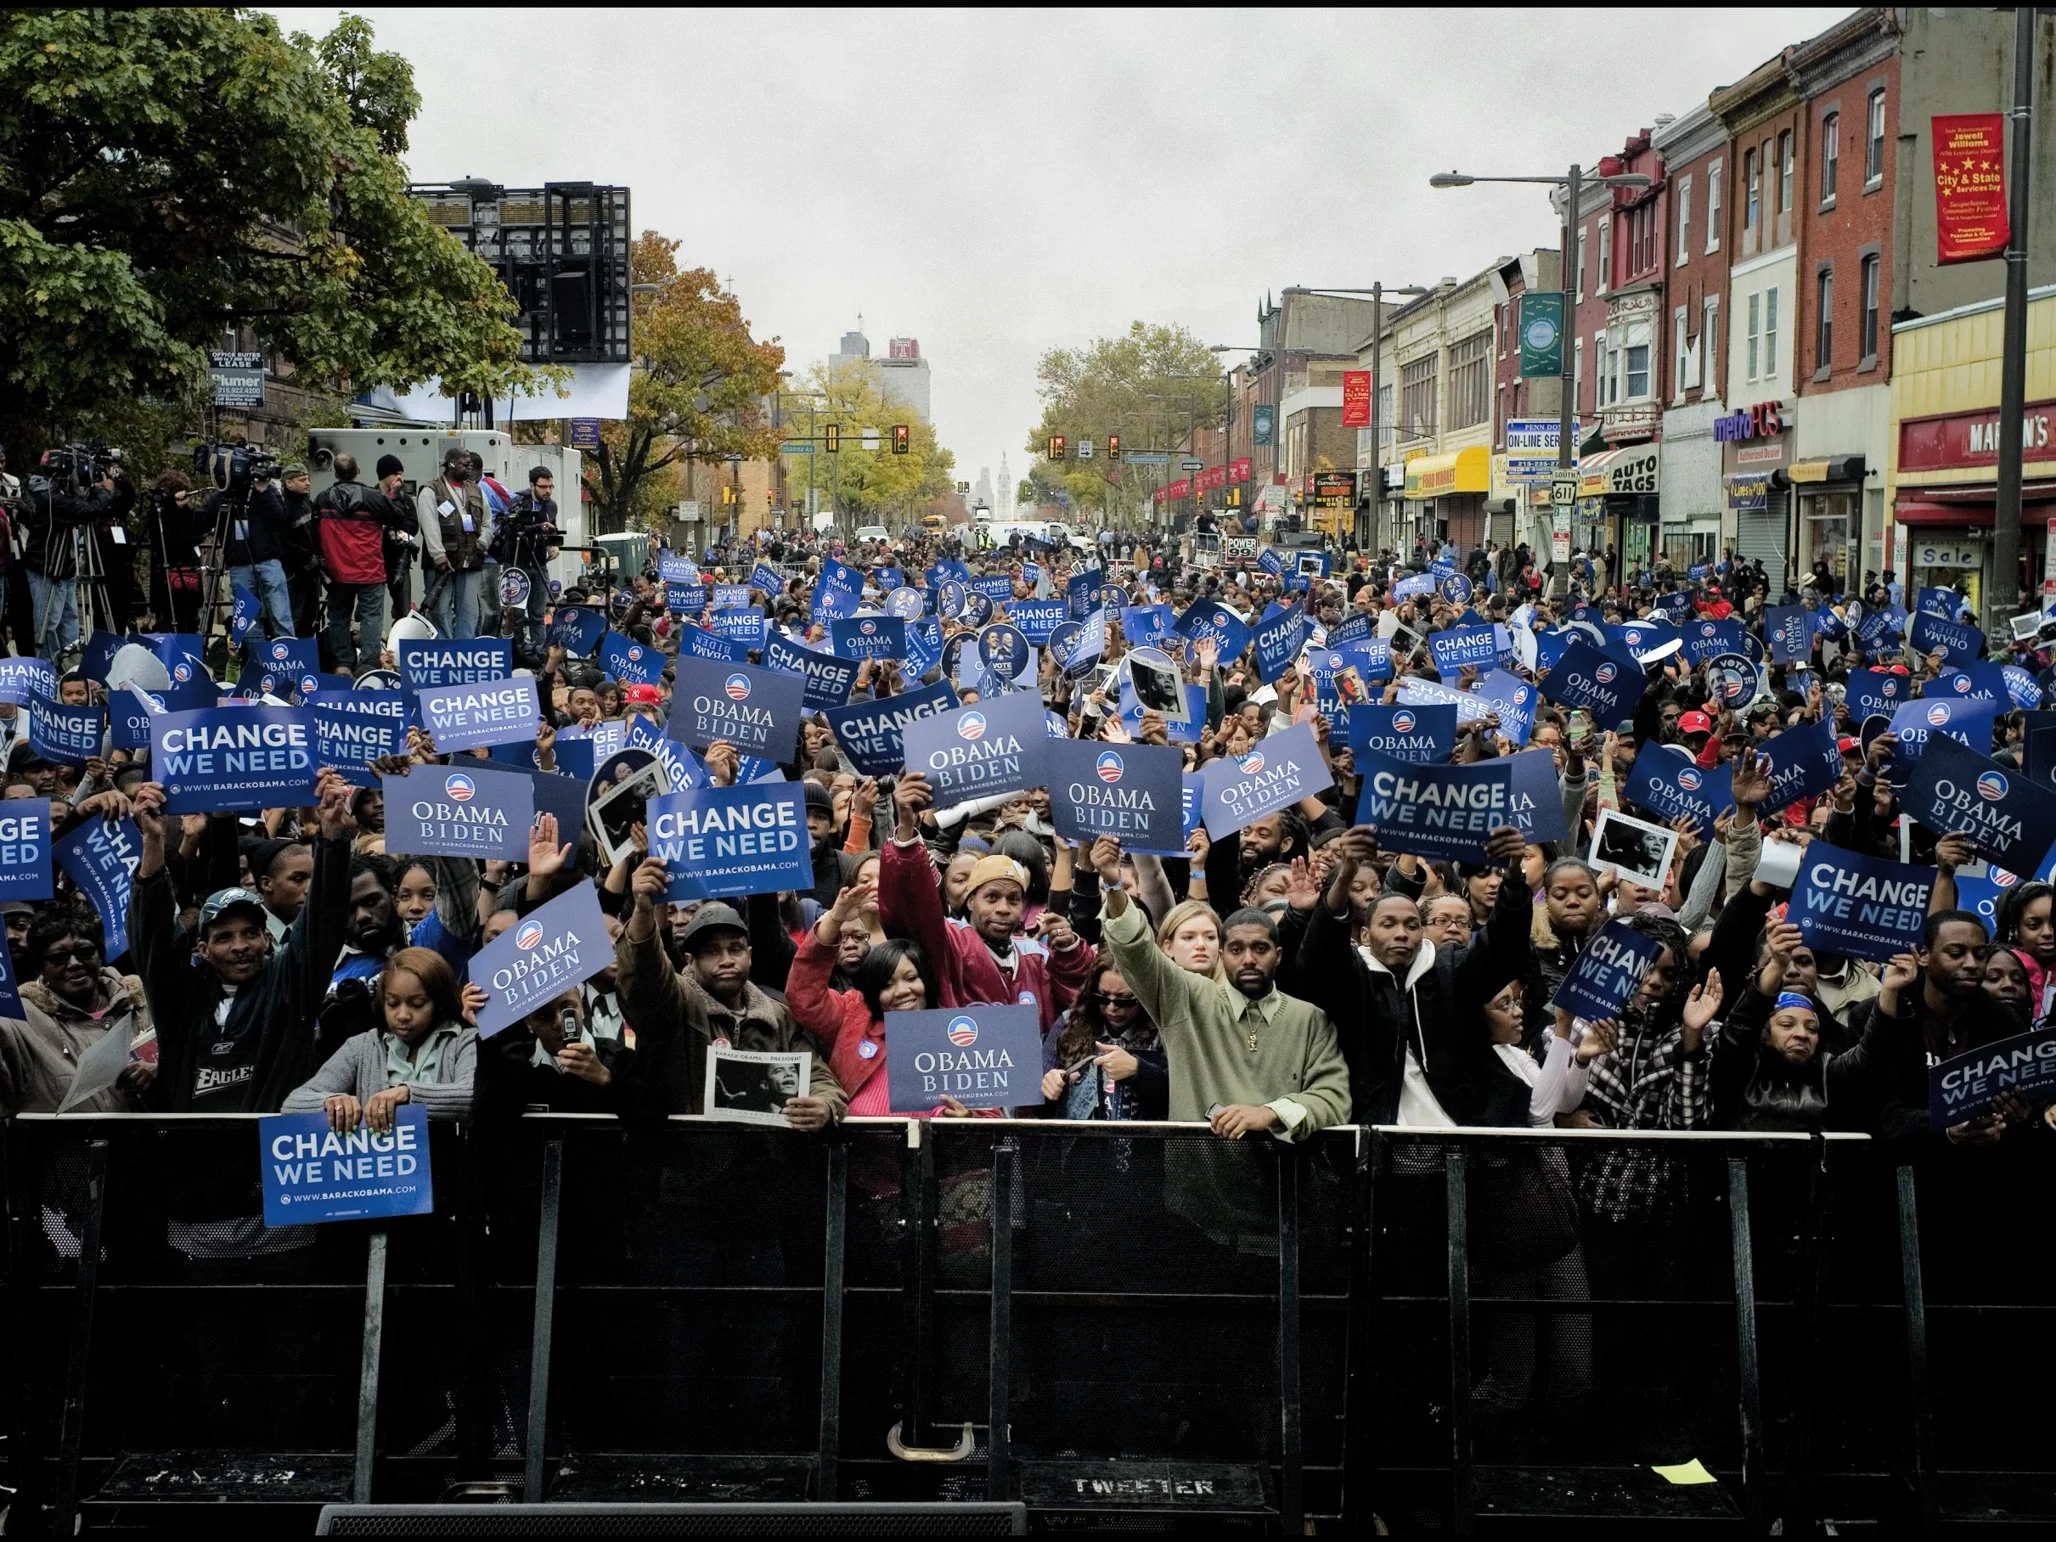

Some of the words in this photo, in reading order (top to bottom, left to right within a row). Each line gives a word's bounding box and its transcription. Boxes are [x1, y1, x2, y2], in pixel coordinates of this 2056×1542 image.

[1949, 139, 1989, 148] Williams
[1955, 132, 1983, 140] Jewell
[1938, 175, 1958, 187] City
[1961, 174, 1969, 185] &
[1973, 173, 2000, 183] State
[1989, 184, 2000, 192] Day
[1714, 400, 1780, 442] metroPCS
[1508, 434, 1541, 447] ON-LINE
[1545, 434, 1578, 447] SERE
[1423, 472, 1434, 487] FOOD
[1436, 469, 1455, 485] MARKET
[1613, 456, 1656, 479] AUTO
[1555, 488, 1572, 499] 611
[1613, 475, 1655, 492] TAGS
[1229, 540, 1256, 548] POWER
[1229, 548, 1252, 556] 99
[662, 560, 696, 571] CHANGE
[1924, 547, 1972, 564] Sale
[756, 568, 779, 587] CHANGE
[1432, 564, 1455, 572] CHANGE
[826, 576, 852, 593] OBAMA
[974, 579, 1011, 591] CHANGE
[986, 585, 1011, 594] NEED
[1289, 576, 1308, 584] OBAMA
[669, 590, 704, 598] CHANGE
[813, 606, 844, 619] OBAMA
[1008, 608, 1064, 620] CHANGE
[729, 625, 760, 635] NEED
[1031, 619, 1064, 630] NEED
[1192, 616, 1230, 649] OBAMA
[1260, 609, 1303, 648] CHANGE
[1787, 615, 1795, 653] OBAMA
[1929, 623, 1968, 641] BIDEN
[695, 635, 732, 654] BIDEN
[846, 635, 893, 648] OBAMA
[851, 644, 890, 656] BIDEN
[1434, 632, 1493, 652] CHANGE
[1691, 637, 1729, 651] OBAMA
[1923, 629, 1968, 651] OBAMA
[407, 651, 505, 668] CHANGE
[692, 642, 732, 661] OBAMA
[1262, 647, 1283, 662] WE
[1438, 650, 1459, 662] WE
[1462, 645, 1493, 659] NEED
[1695, 647, 1727, 656] BIDEN
[610, 653, 647, 679] OBAMA
[769, 642, 851, 684] CHANGE
[1720, 659, 1747, 674] VOTE
[1, 664, 55, 689] HANGE
[408, 670, 441, 684] WE
[461, 669, 504, 683] NEED
[2003, 670, 2043, 698] CHANGE
[430, 687, 531, 714] CHANGE
[1407, 682, 1489, 713] CHANGE
[1407, 691, 1429, 706] WE
[1567, 673, 1618, 708] OBAMA
[693, 696, 775, 728] OBAMA
[1492, 698, 1529, 724] OBAMA
[1562, 689, 1610, 716] BIDEN
[31, 699, 97, 735] CHANGE
[432, 710, 468, 729] WE
[474, 704, 532, 724] NEED
[840, 696, 950, 739] CHANGE
[1697, 715, 1705, 724] P
[32, 718, 45, 737] WE
[48, 727, 96, 750] NEED
[161, 723, 308, 753] CHANGE
[316, 718, 392, 746] HANGE
[447, 722, 533, 738] WWW.BARACKOBAMA.COM
[696, 716, 768, 743] BIDEN
[847, 736, 885, 756] WE
[929, 734, 1024, 770] OBAMA
[1369, 736, 1436, 750] OBAMA
[163, 754, 214, 776] WE
[225, 750, 309, 773] NEED
[937, 755, 1021, 788] BIDEN
[183, 779, 309, 792] WWW.BARACKOBAMA.COM
[943, 774, 1022, 796] WWW.BARACKOBAMA.COM
[1220, 760, 1302, 805] OBAMA
[1373, 771, 1505, 810] CHANGE
[1068, 783, 1155, 812] OBAMA
[1230, 773, 1301, 817] BIDEN
[1237, 787, 1303, 821] WWW.BARACKOBAMA.COM
[1649, 777, 1711, 818] OBAMA
[412, 801, 509, 826] OBAMA
[655, 801, 797, 839] CHANGE
[1075, 806, 1150, 831] BIDEN
[1370, 794, 1417, 824] WE
[1425, 808, 1505, 833] NEED
[1934, 779, 2022, 841] OBAMA
[420, 823, 503, 843] BIDEN
[1078, 827, 1150, 839] WWW.BARACKOBAMA.COM
[1930, 799, 2012, 852] BIDEN
[86, 827, 119, 871] WE
[422, 840, 504, 851] WWW.BARACKOBAMA.COM
[656, 838, 706, 864] WE
[716, 830, 799, 858] NEED
[676, 861, 799, 879] WWW.BARACKOBAMA.COM
[1810, 863, 1929, 908] CHANGE
[1806, 887, 1853, 919] WE
[1859, 903, 1921, 932] NEED
[492, 929, 582, 991] OBAMA
[503, 948, 582, 1007] BIDEN
[1577, 957, 1606, 987] WE
[510, 966, 583, 1013] WWW.BARACKOBAMA.COM
[714, 1050, 739, 1059] BARACK
[740, 1054, 762, 1062] OBAMA
[770, 1055, 802, 1064] PRESIDENT
[914, 1048, 1014, 1075] OBAMA
[1941, 1040, 2056, 1090] CHANG
[922, 1070, 1010, 1093] BIDEN
[1942, 1080, 1988, 1105] WE
[270, 1125, 417, 1160] CHANGE
[273, 1161, 323, 1186] WE
[333, 1153, 416, 1182] NEED
[293, 1184, 416, 1202] WWW.BARACKOBAMA.COM
[1072, 1479, 1215, 1495] TWEETER
